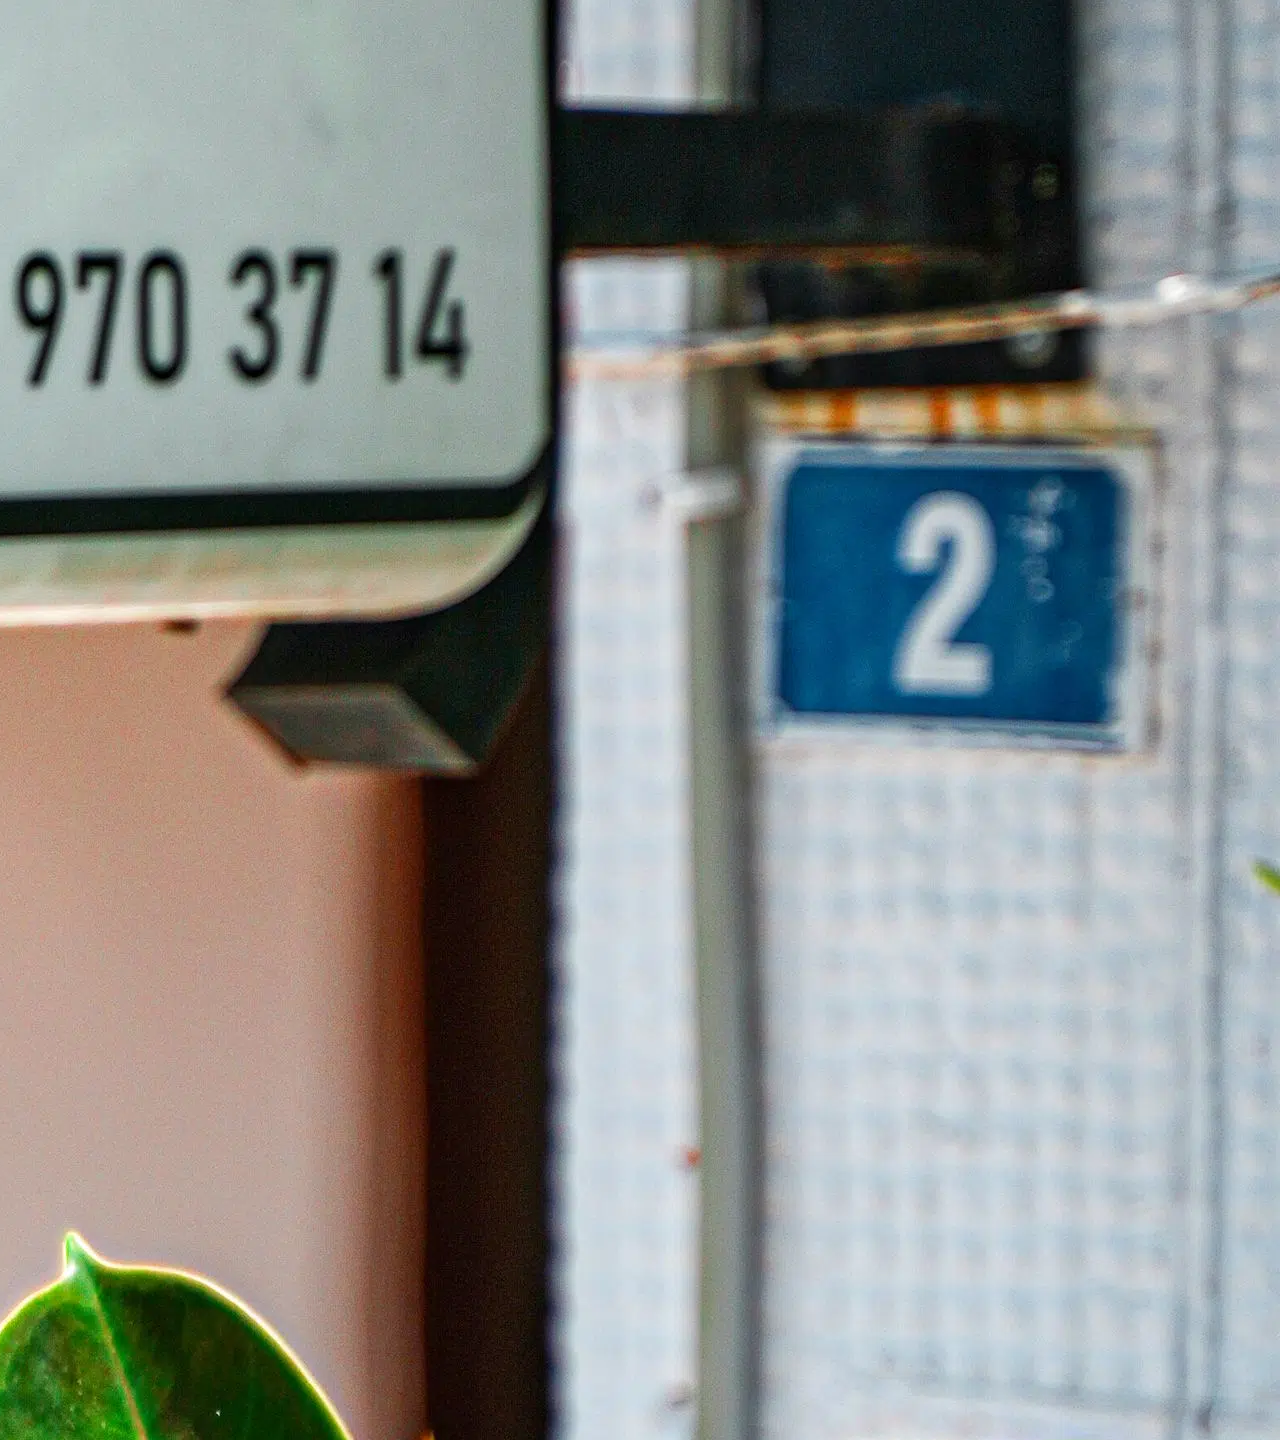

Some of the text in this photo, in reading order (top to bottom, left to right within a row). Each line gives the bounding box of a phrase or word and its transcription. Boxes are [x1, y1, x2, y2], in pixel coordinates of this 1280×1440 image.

[14, 248, 190, 389] 970
[228, 246, 339, 387] 37
[371, 246, 471, 383] 14
[892, 488, 998, 698] 2
